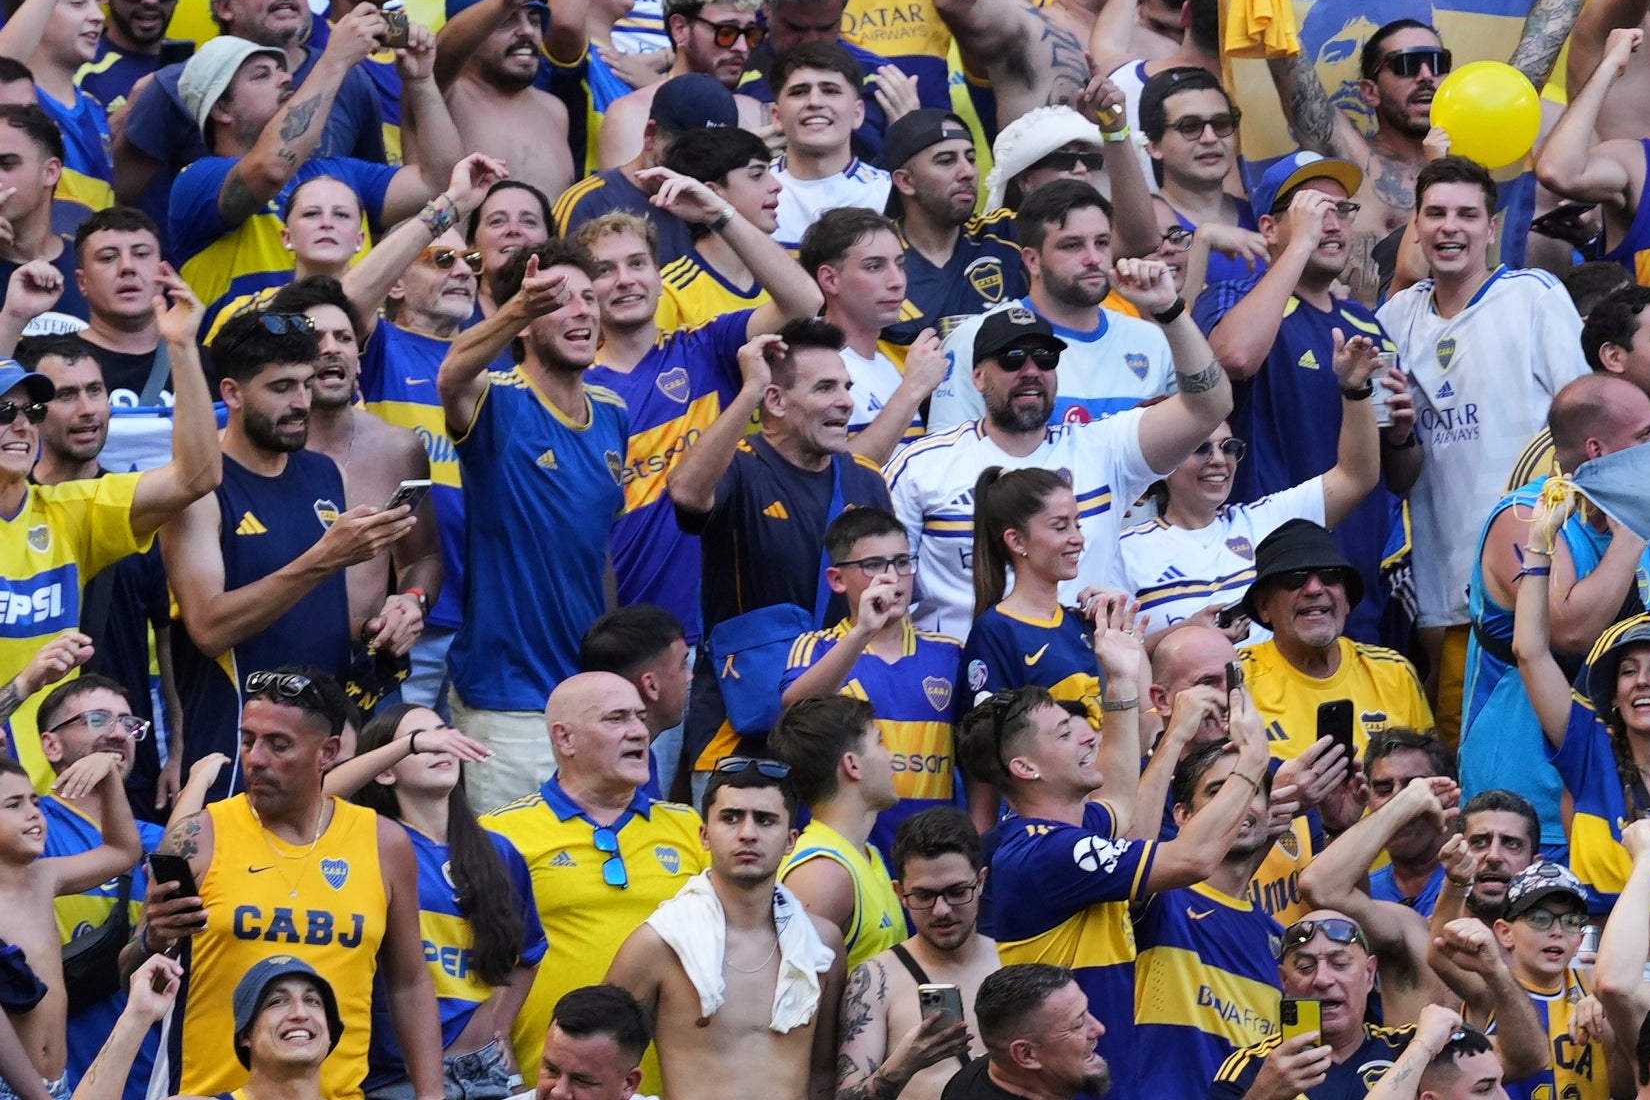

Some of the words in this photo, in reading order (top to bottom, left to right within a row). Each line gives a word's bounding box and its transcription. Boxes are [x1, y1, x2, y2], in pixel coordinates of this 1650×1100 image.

[843, 3, 924, 37] QATAR
[860, 26, 928, 43] AIRWAYS
[1421, 403, 1481, 432] QATAR
[0, 583, 62, 625] EPSI
[888, 753, 951, 775] sson
[232, 904, 366, 949] CABJ
